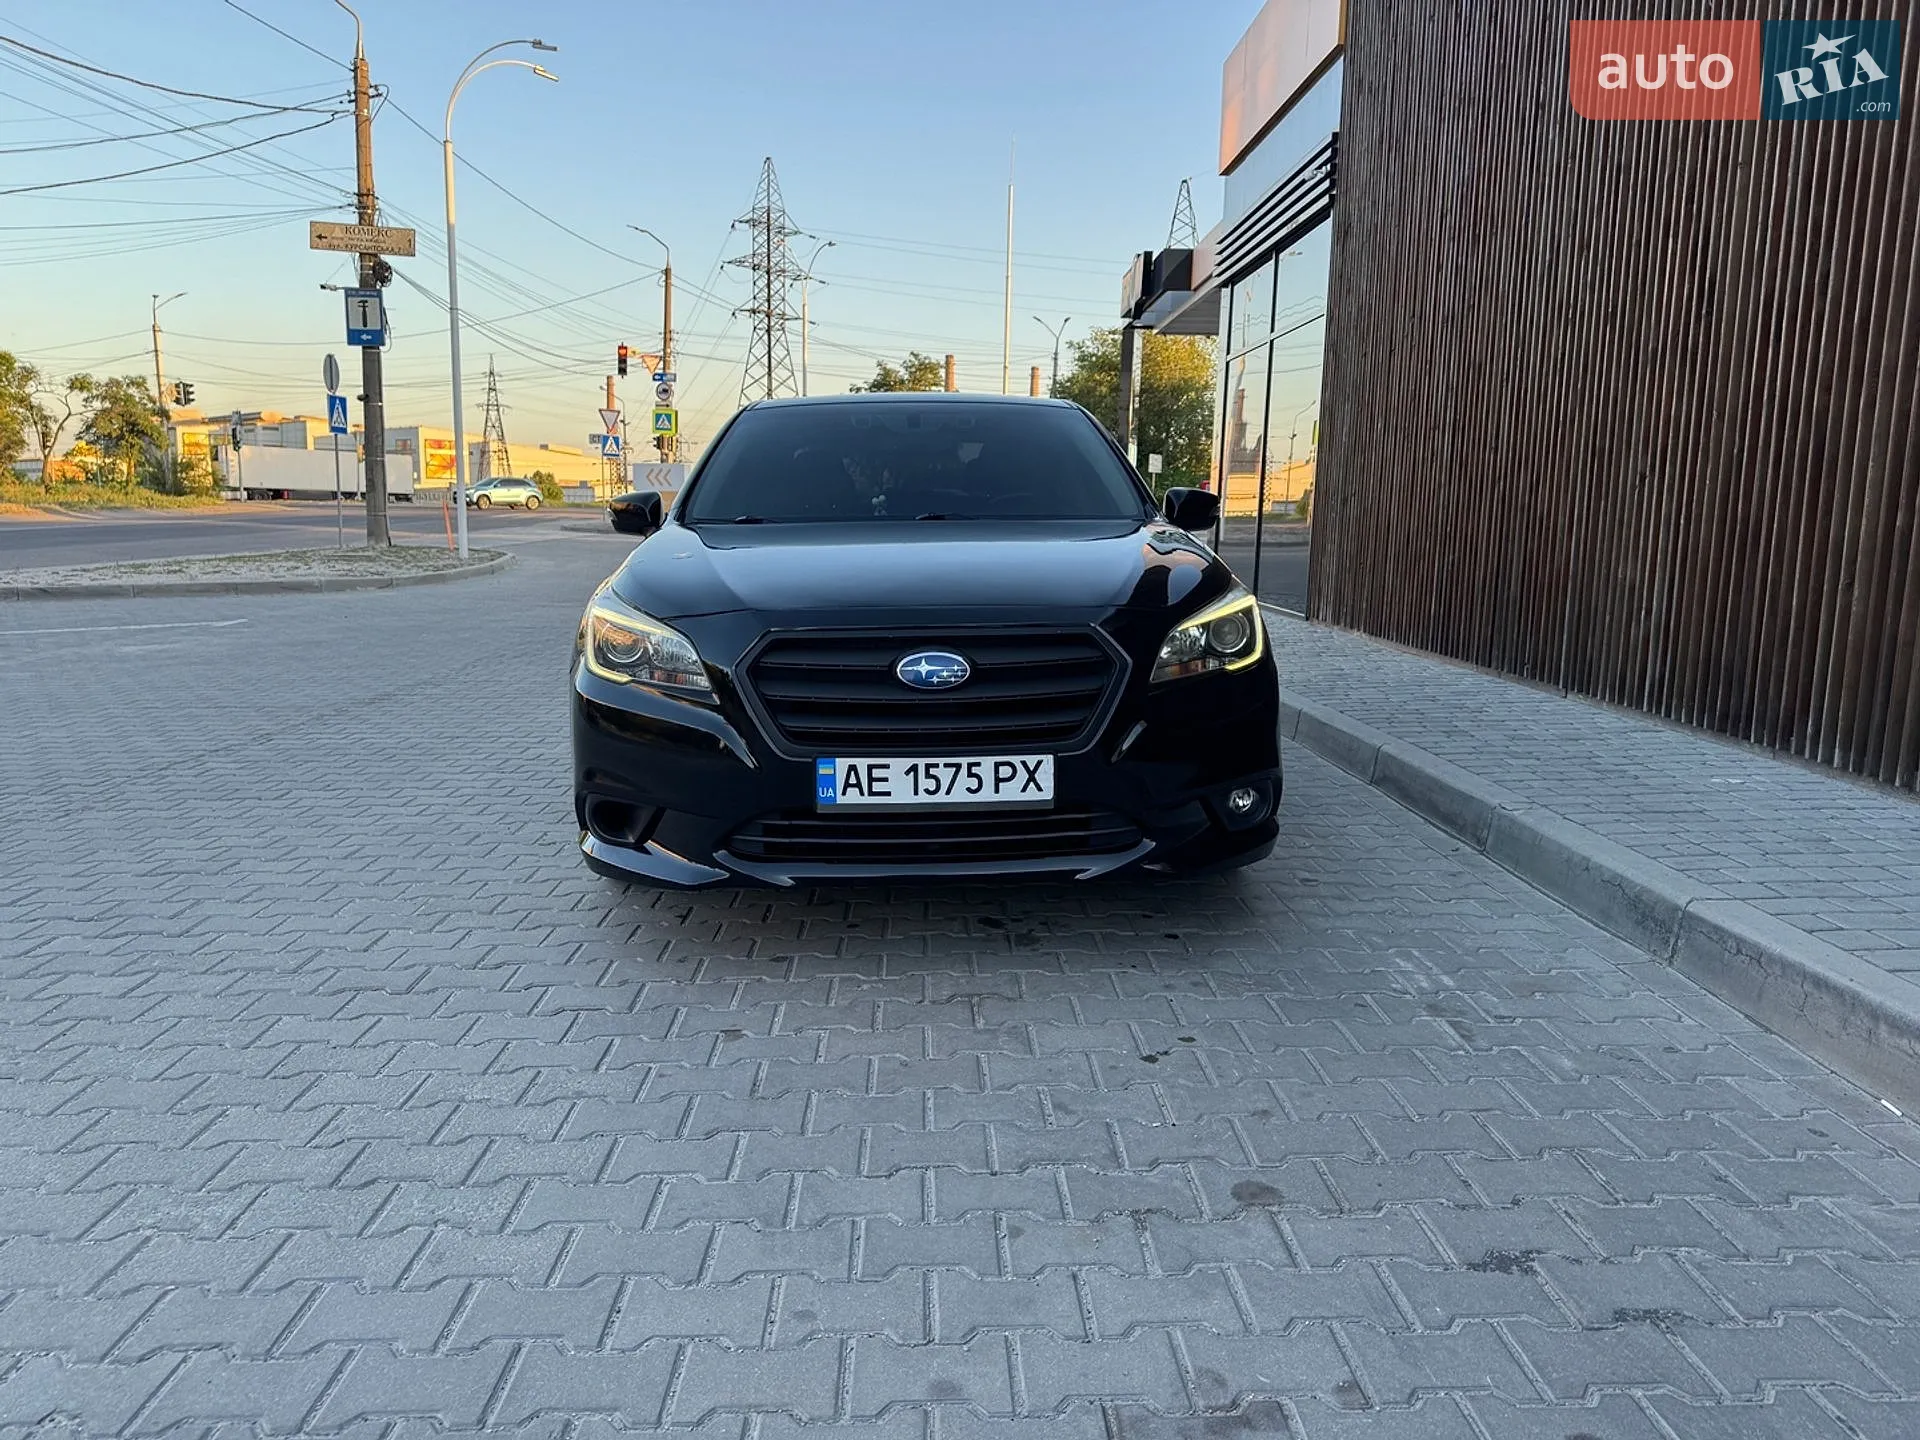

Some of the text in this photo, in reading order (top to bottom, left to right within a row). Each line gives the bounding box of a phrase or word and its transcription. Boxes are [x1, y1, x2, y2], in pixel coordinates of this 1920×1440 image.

[345, 226, 393, 238] КОМЕКС
[841, 759, 1044, 797] AE 1575 PX
[819, 787, 835, 798] UA
